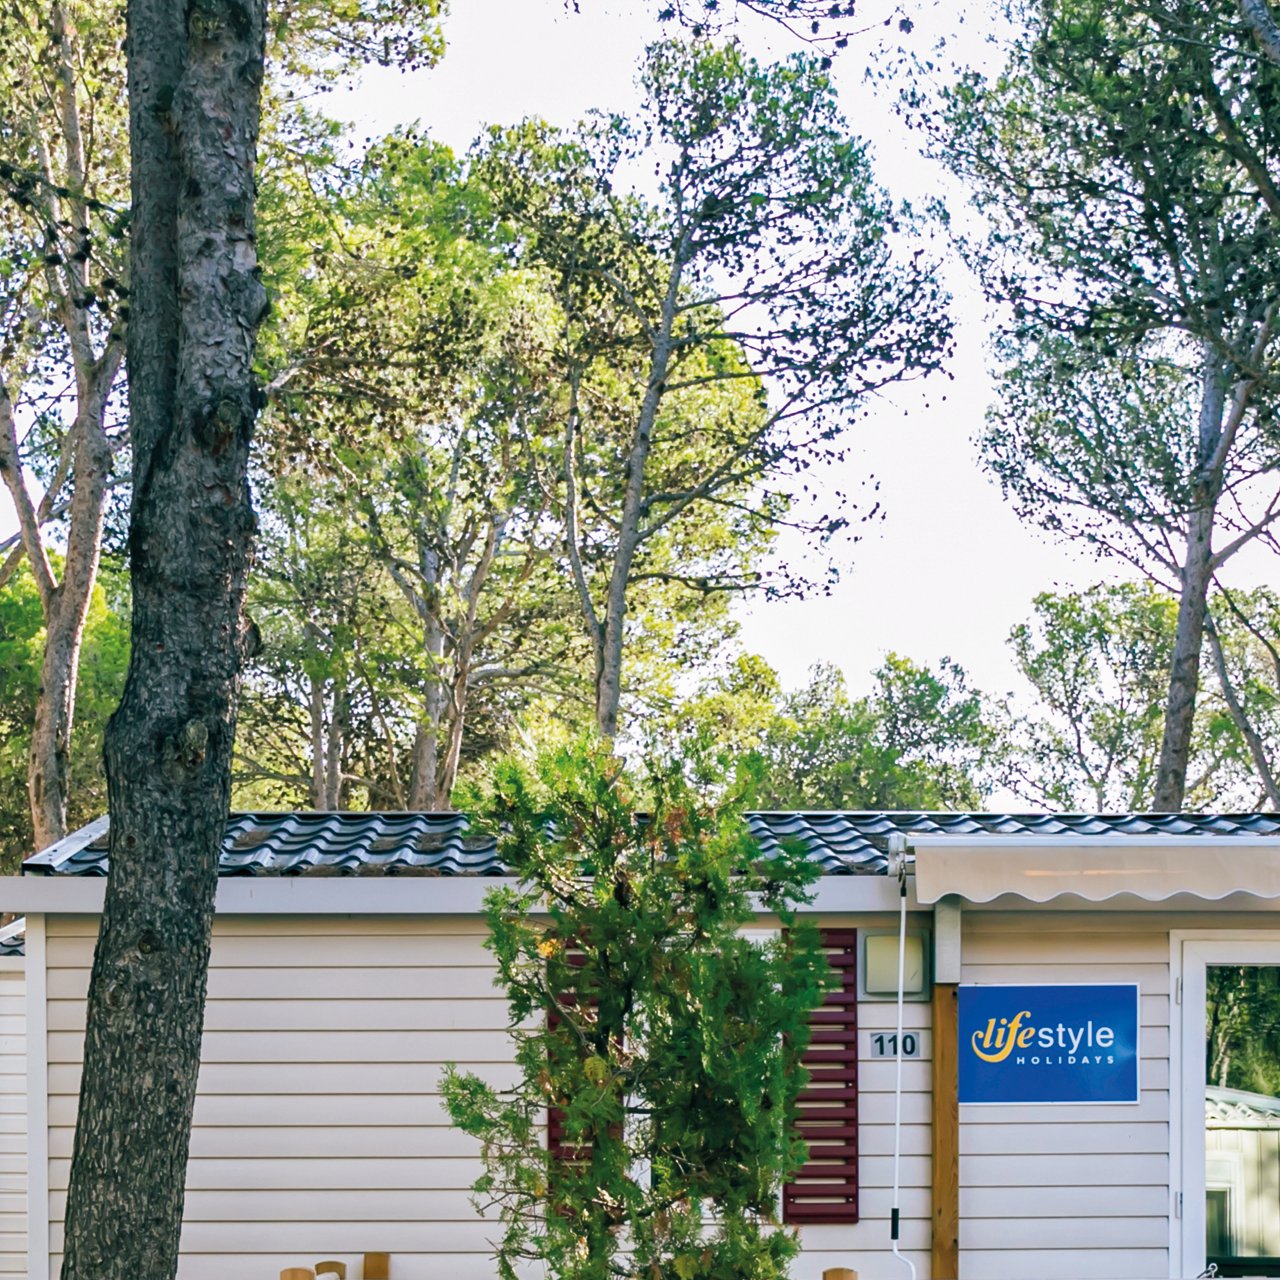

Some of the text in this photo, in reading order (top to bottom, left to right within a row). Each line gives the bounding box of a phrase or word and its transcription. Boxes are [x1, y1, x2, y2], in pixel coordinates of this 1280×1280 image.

[874, 1034, 916, 1056] 110
[972, 1010, 1115, 1063] lifestyle
[1016, 1055, 1115, 1065] HOLIDAYS
